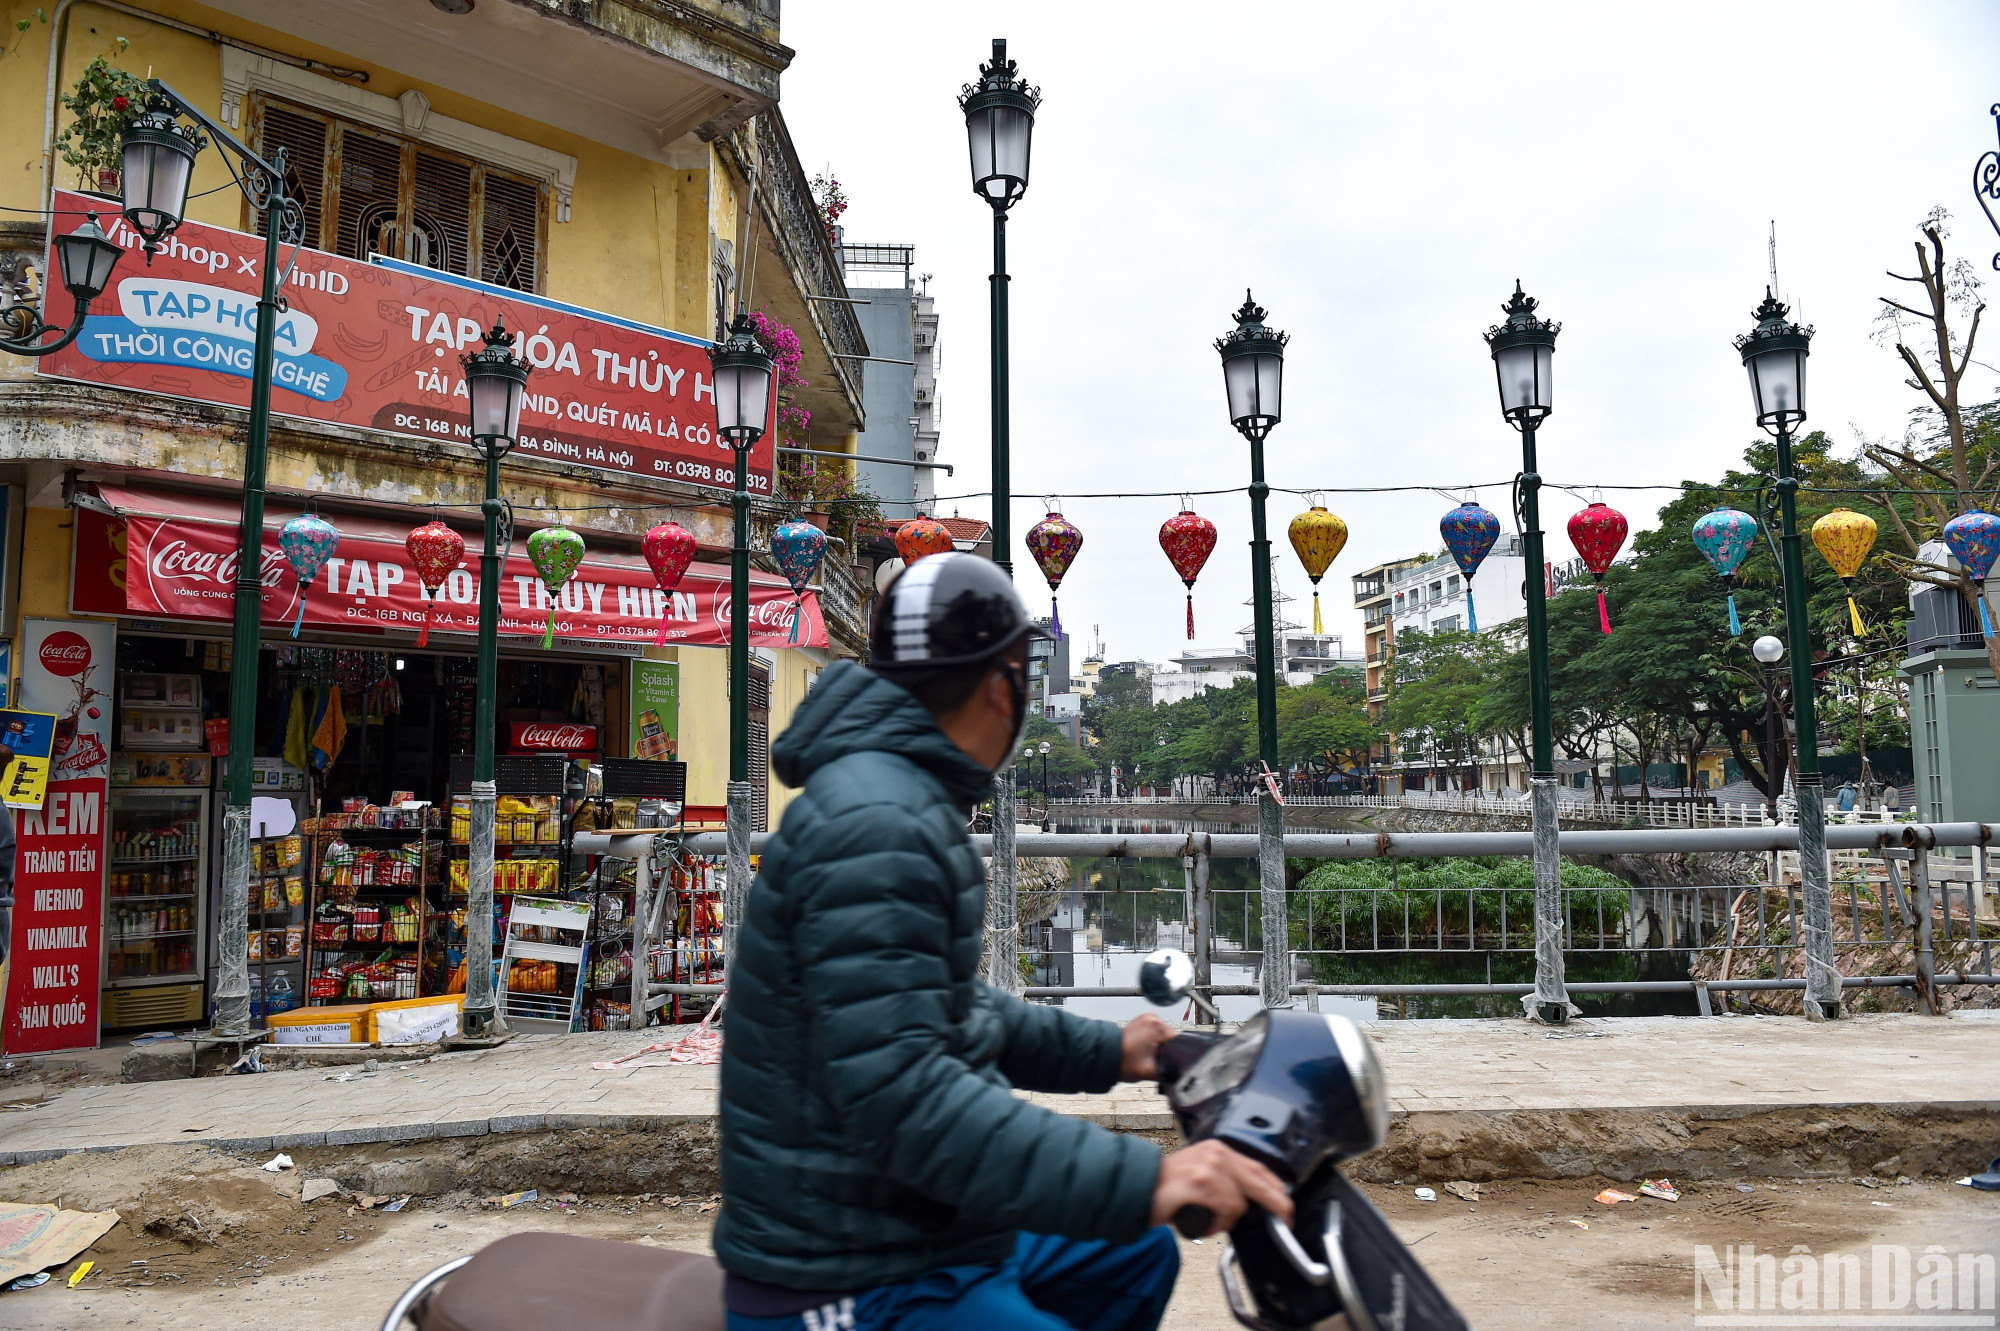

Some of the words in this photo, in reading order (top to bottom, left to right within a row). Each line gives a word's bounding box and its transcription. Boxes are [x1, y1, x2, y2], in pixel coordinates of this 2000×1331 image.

[132, 290, 211, 320] TẠP
[94, 328, 165, 357] THỜI
[173, 338, 252, 369] CÔNG
[405, 305, 481, 357] TẠP
[592, 349, 685, 397] THỦY
[415, 367, 448, 395] TẢI
[566, 402, 619, 427] QUÉT
[622, 411, 653, 434] MÃ
[657, 416, 679, 440] LÀ
[684, 423, 711, 445] CÓ
[394, 414, 421, 429] ĐC:
[425, 418, 450, 434] 16B
[520, 436, 539, 450] BA
[542, 437, 582, 459] ĐÌNH,
[586, 446, 606, 462] HÀ
[609, 450, 634, 468] NỘI
[653, 460, 673, 474] ĐT:
[676, 461, 711, 480] 0378
[715, 468, 736, 484] 80
[152, 540, 287, 588] Coca-Cla
[326, 557, 404, 605] TẠP
[419, 562, 502, 604] HÓ
[346, 607, 371, 619] ĐC:
[375, 608, 398, 620] 16B
[553, 620, 573, 633] NỘI
[597, 625, 615, 635] ĐT:
[618, 627, 687, 638] 0378.80.312
[716, 595, 796, 628] Ca-Cola
[40, 644, 89, 660] Coca-Cola
[641, 672, 674, 687] Splash
[520, 724, 586, 748] Coca-Cola
[24, 846, 65, 874] TRÀNG
[34, 888, 84, 911] MERINO
[27, 926, 87, 950] VINAMILK
[33, 964, 79, 989] WALL'S
[22, 1002, 51, 1029] HÀN
[52, 994, 86, 1026] QUỐC
